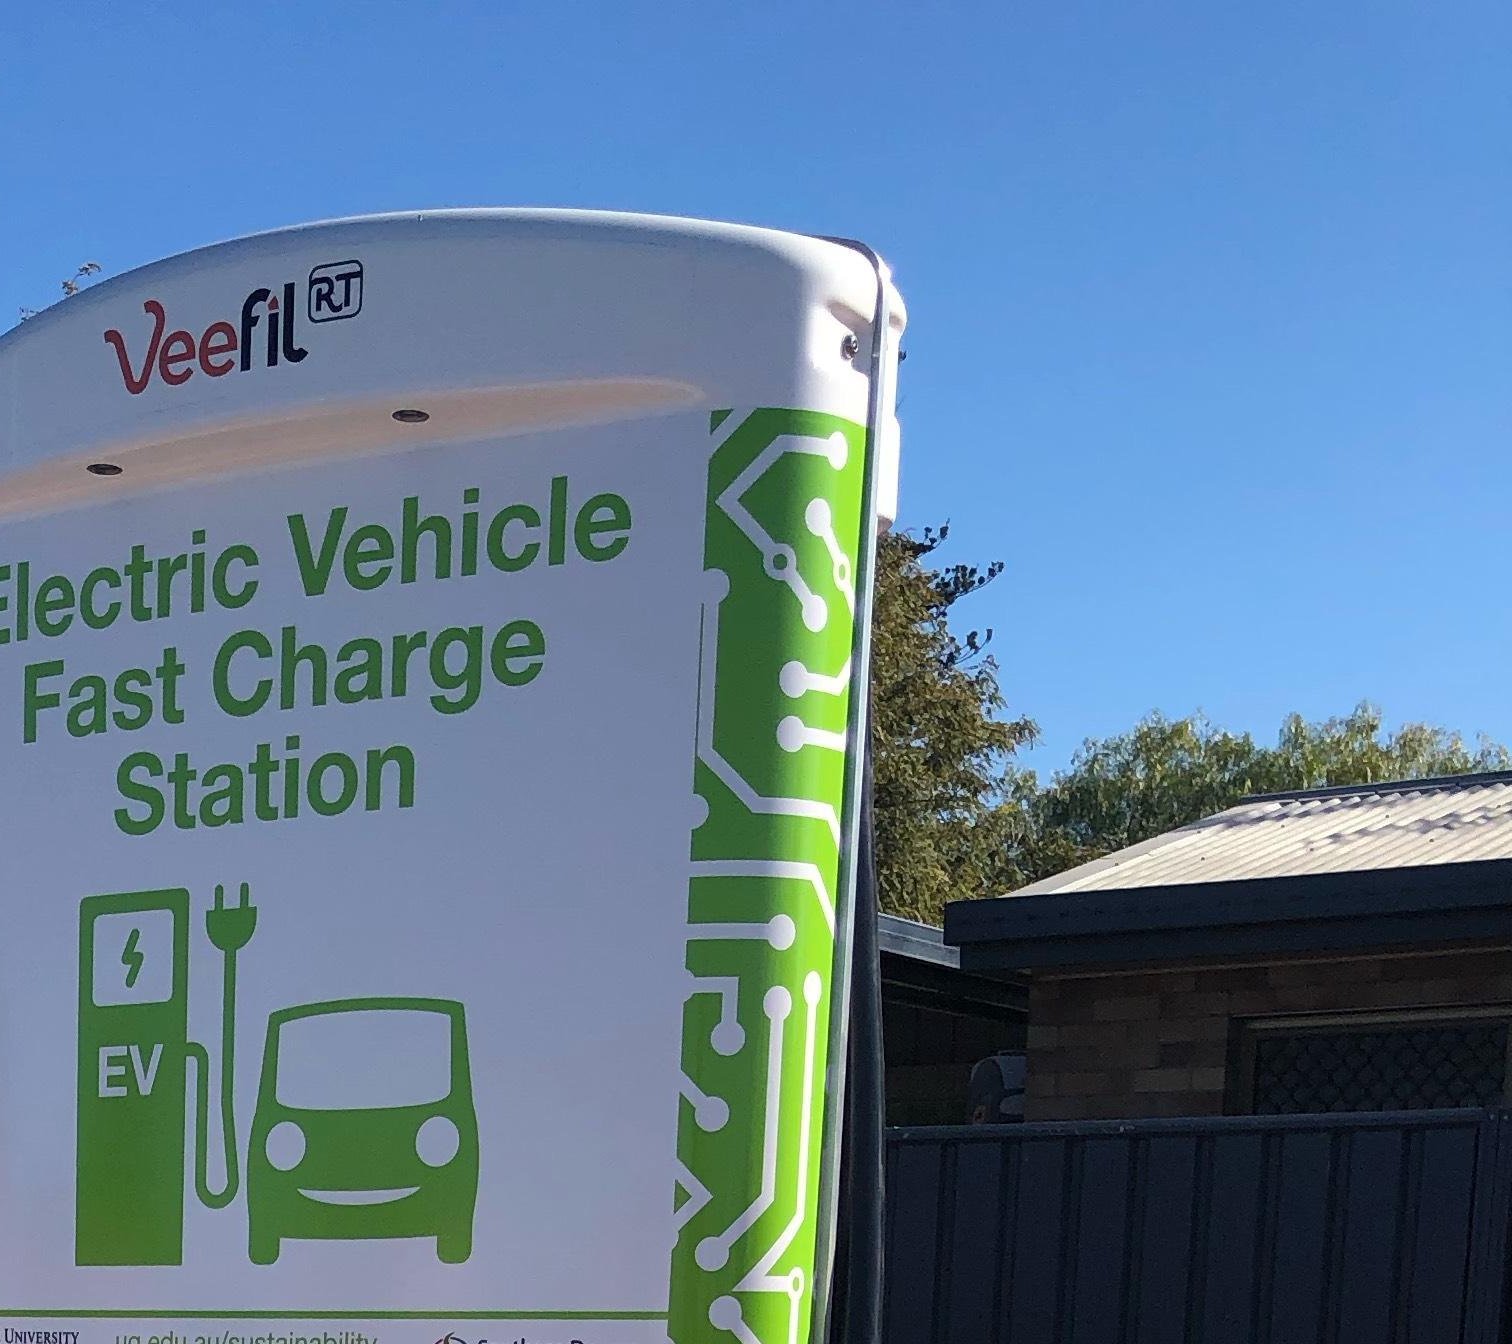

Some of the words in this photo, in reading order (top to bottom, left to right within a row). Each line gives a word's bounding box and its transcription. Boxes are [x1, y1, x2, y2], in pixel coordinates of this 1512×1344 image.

[104, 282, 308, 394] Veefil
[310, 270, 362, 313] RT
[287, 475, 632, 597] Vehicle
[23, 647, 185, 744] Fast
[212, 617, 545, 715] Charge
[113, 734, 415, 836] Station
[98, 1044, 164, 1098] EV
